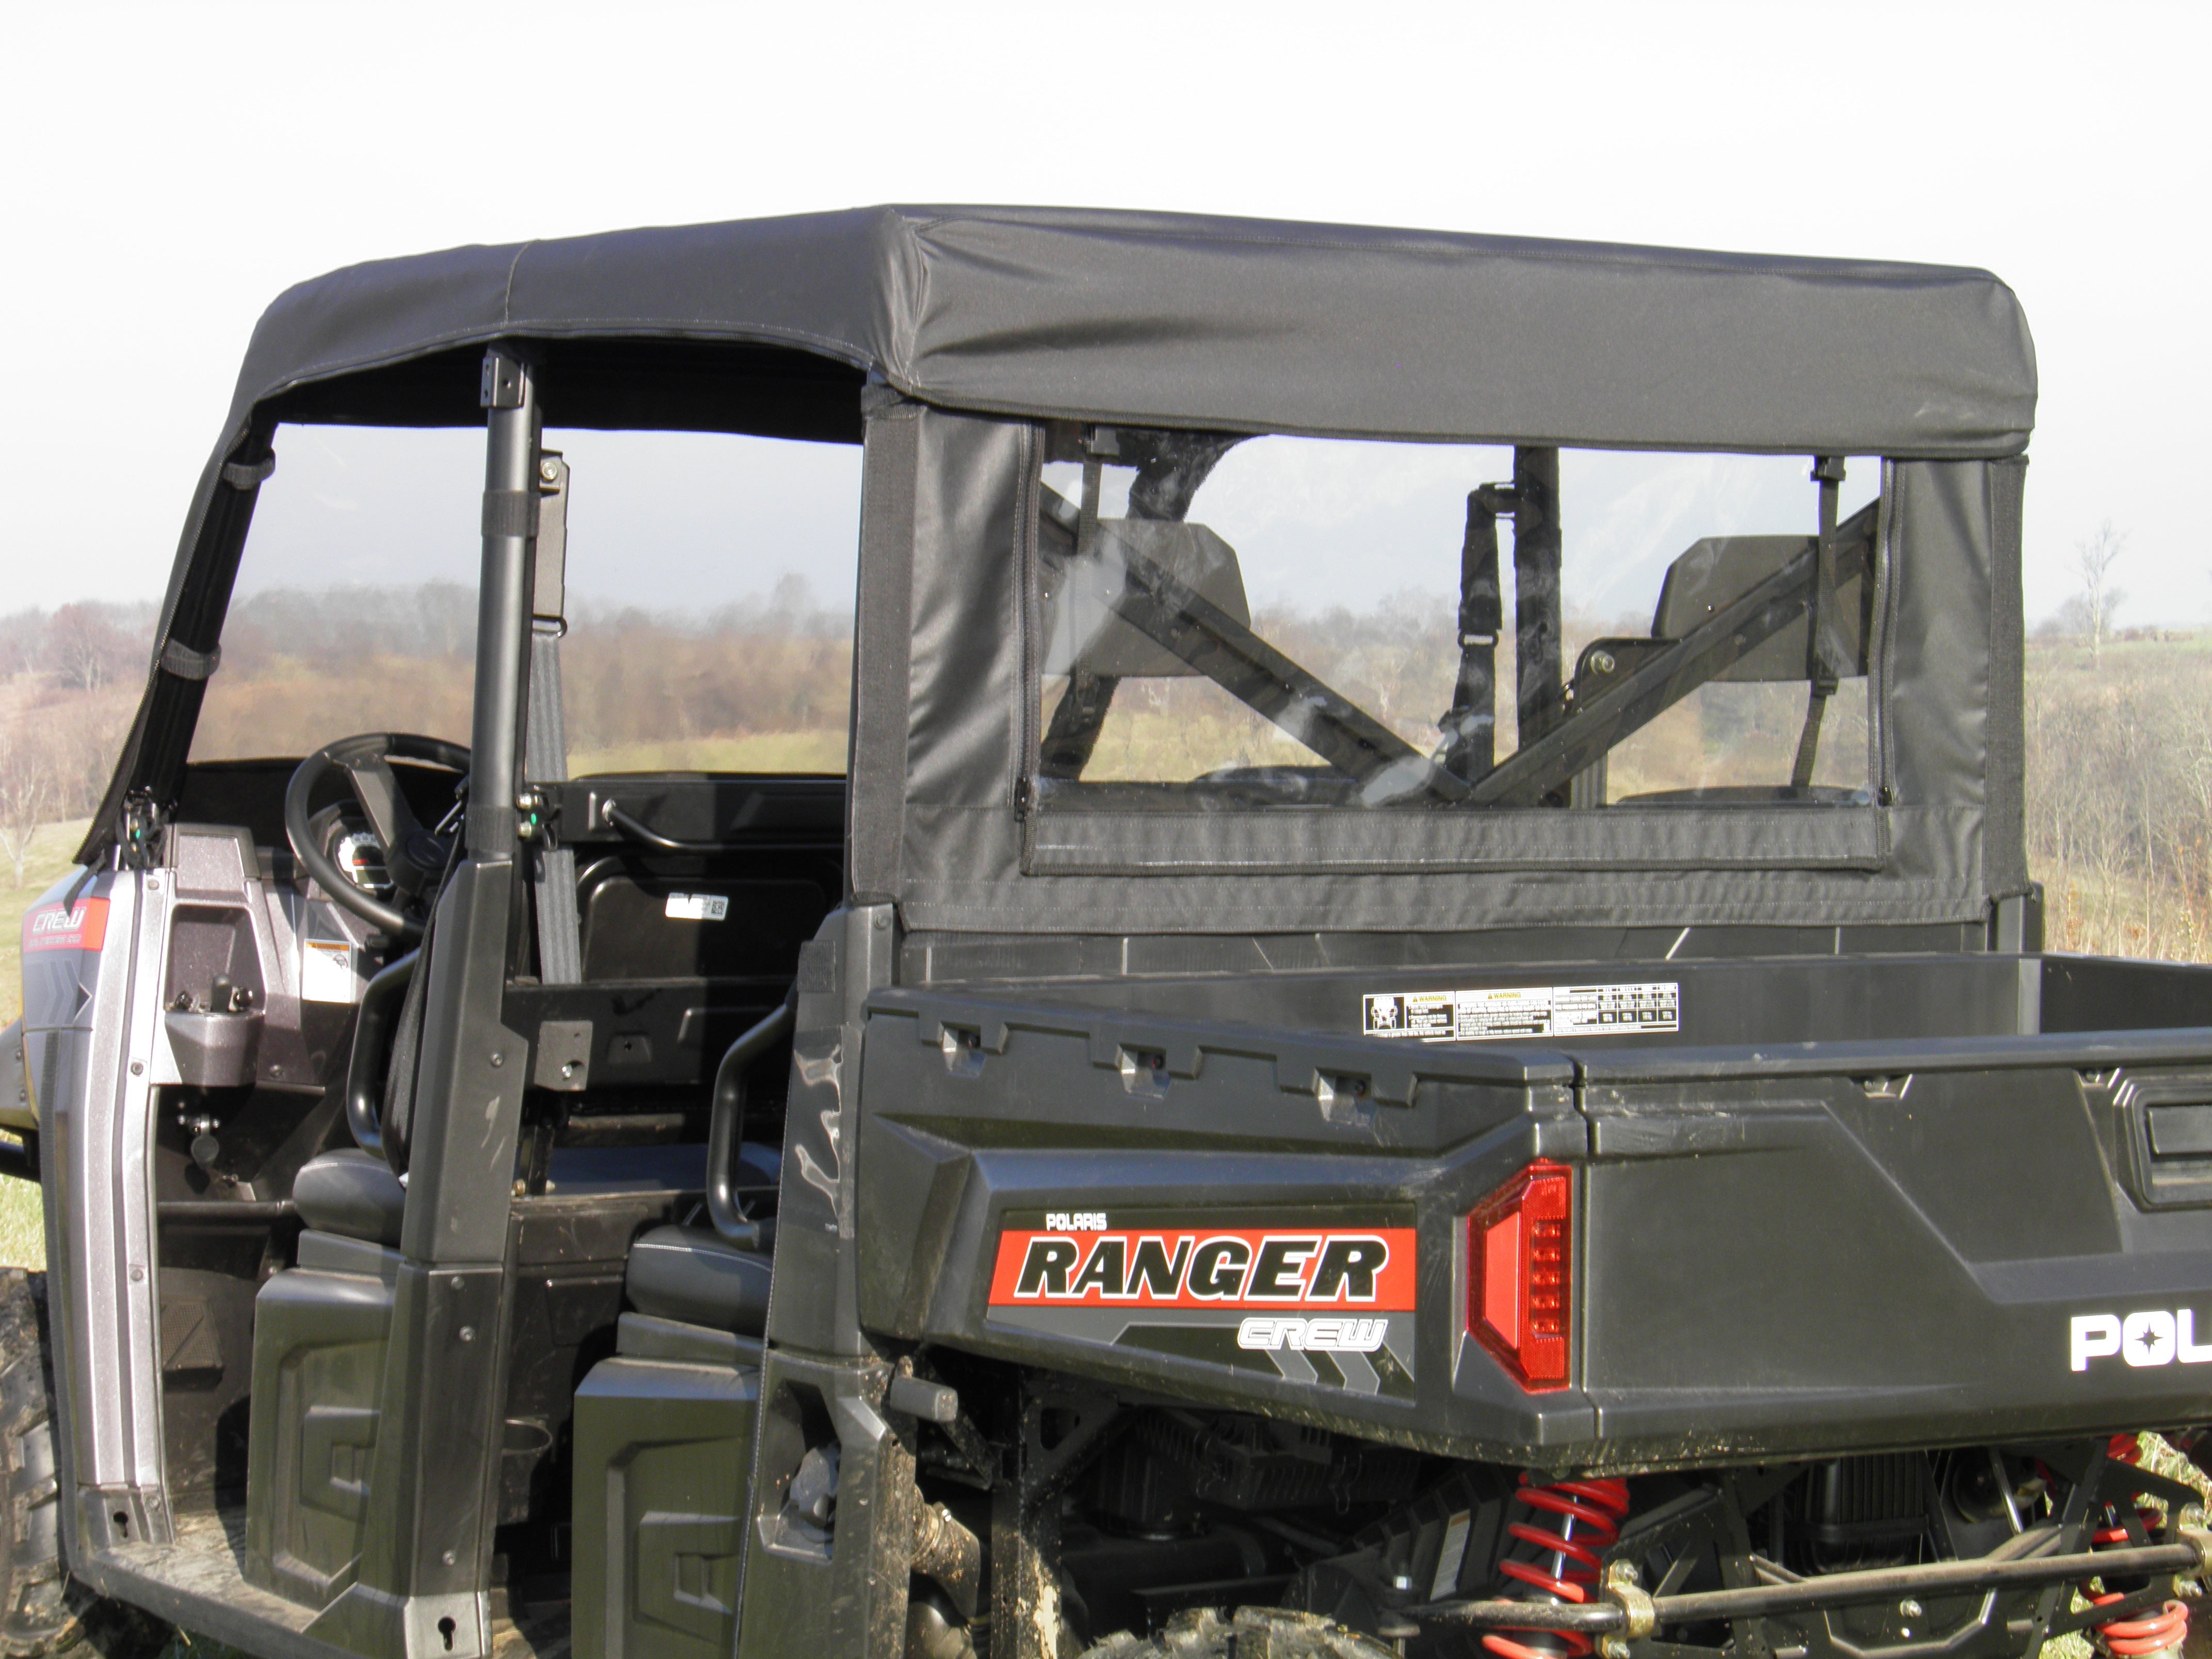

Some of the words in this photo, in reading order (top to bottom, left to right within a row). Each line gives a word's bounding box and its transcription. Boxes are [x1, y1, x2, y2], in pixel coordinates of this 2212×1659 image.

[32, 907, 87, 934] CREW
[1046, 1213, 1107, 1231] POLARIS
[1014, 1235, 1389, 1302] RANGER
[1237, 1318, 1389, 1352] CREW
[2071, 1309, 2212, 1373] POL
